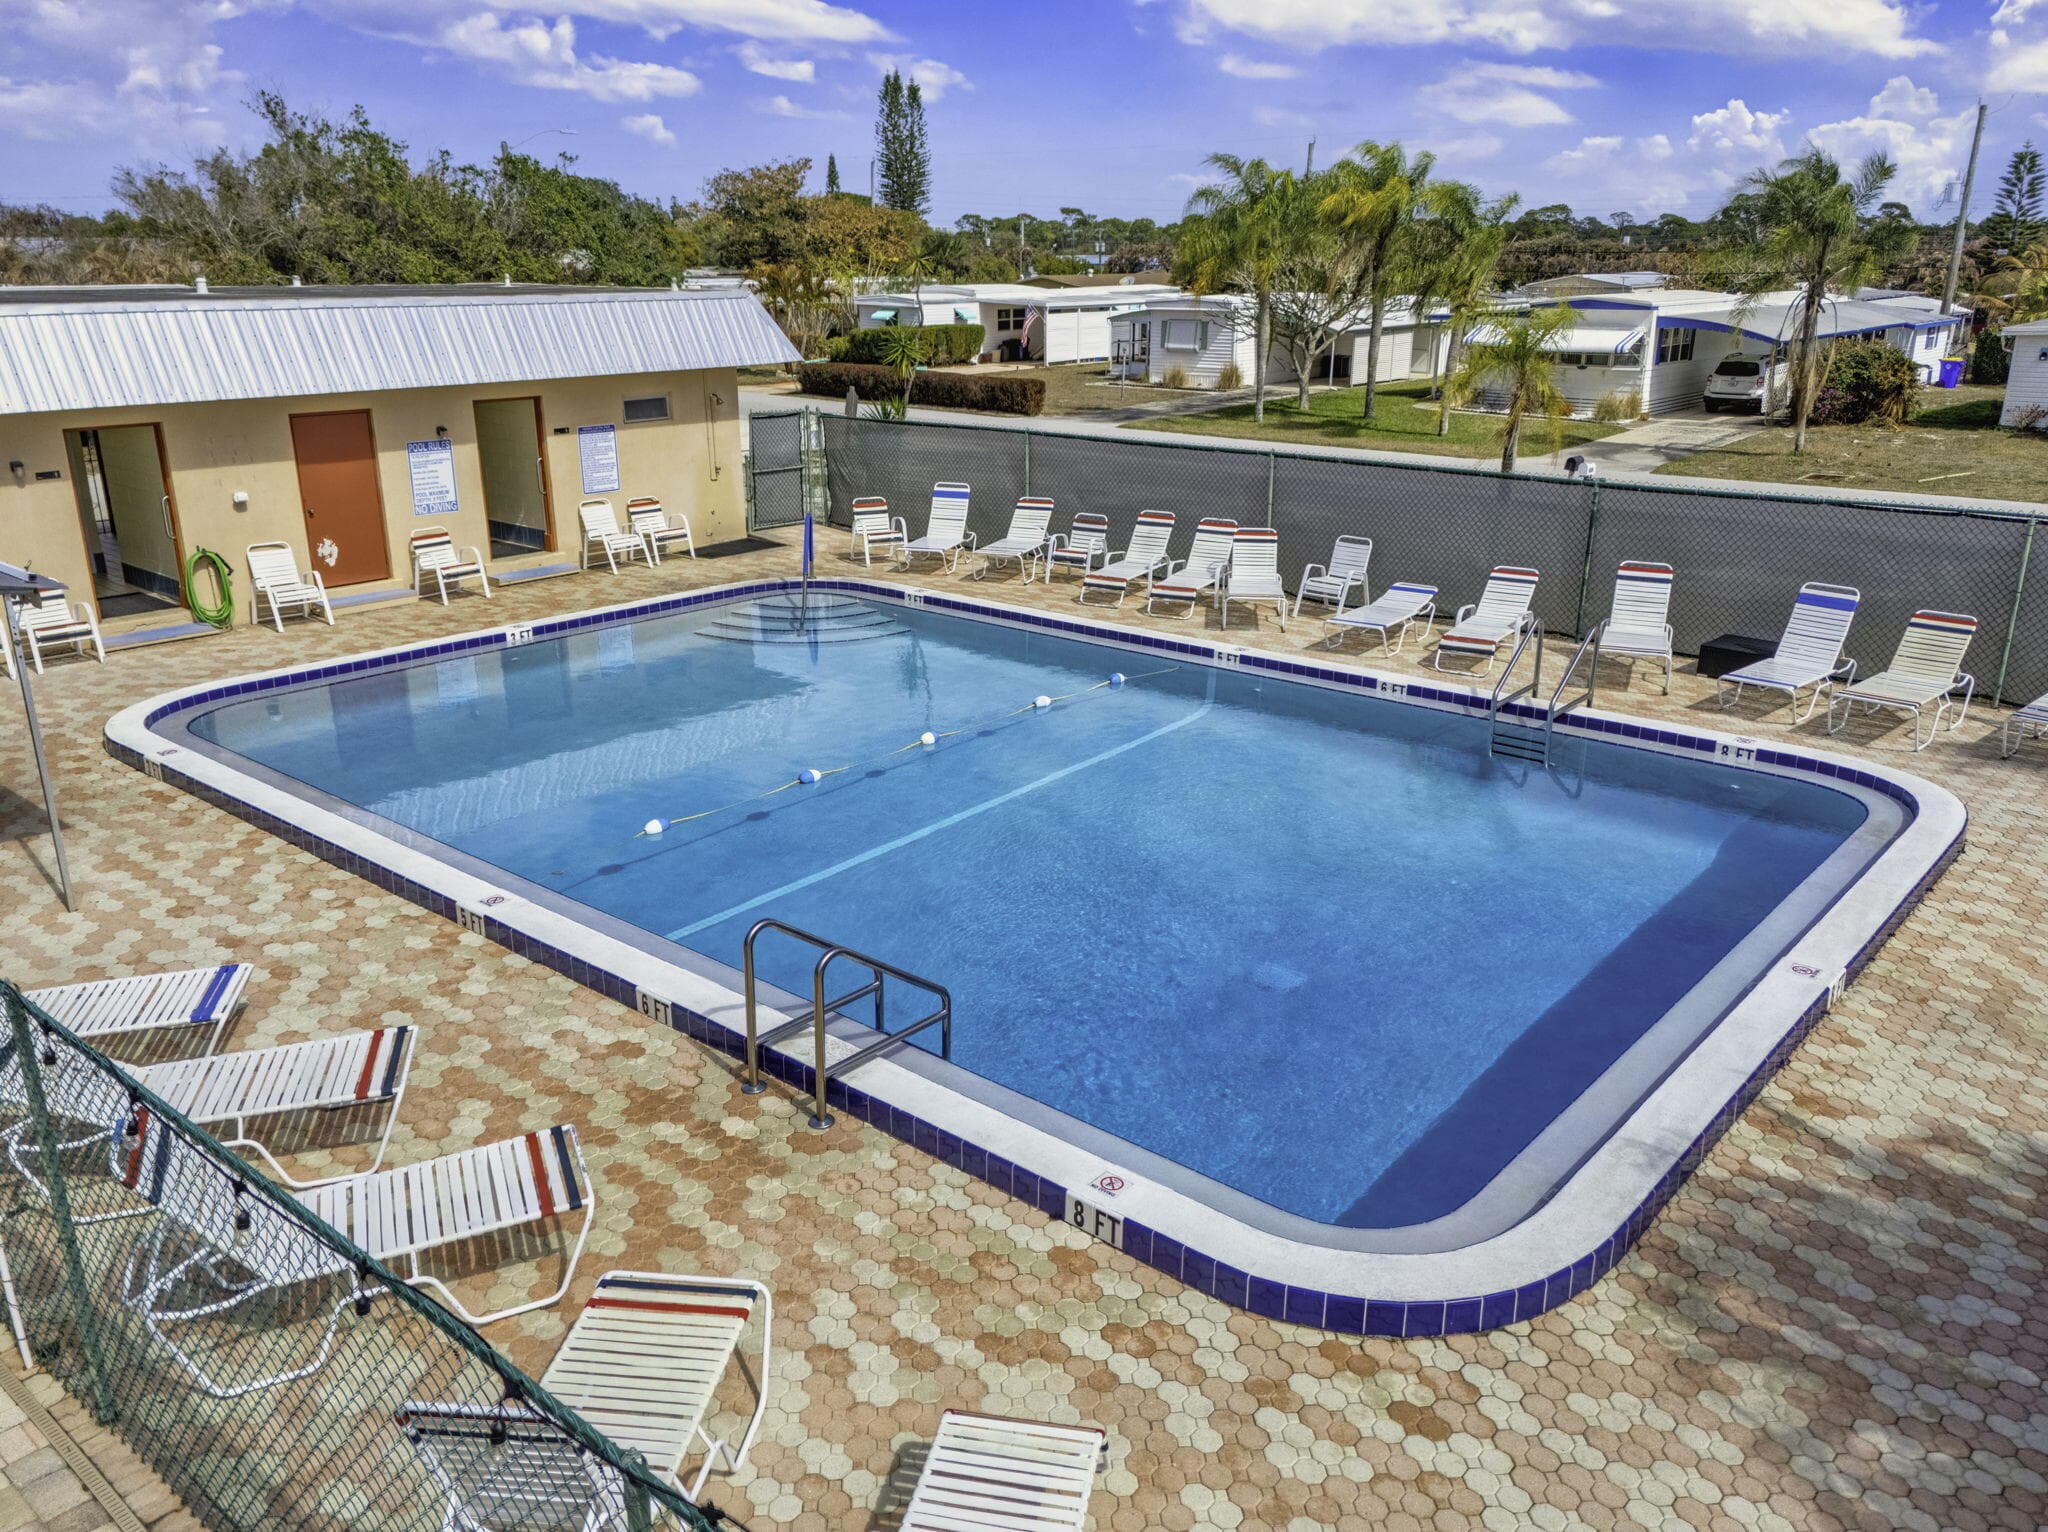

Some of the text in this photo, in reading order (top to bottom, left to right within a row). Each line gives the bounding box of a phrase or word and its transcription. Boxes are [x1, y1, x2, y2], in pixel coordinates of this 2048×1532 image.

[408, 441, 450, 452] POOL RULES
[415, 501, 457, 515] NO DIVING
[519, 629, 531, 639] FT
[1226, 653, 1239, 664] FT
[1381, 682, 1406, 695] 6 FT
[1721, 745, 1755, 761] 8 FT
[460, 907, 483, 936] 5 FT
[641, 993, 670, 1026] 6 FT
[1073, 1199, 1121, 1245] 8 FT
